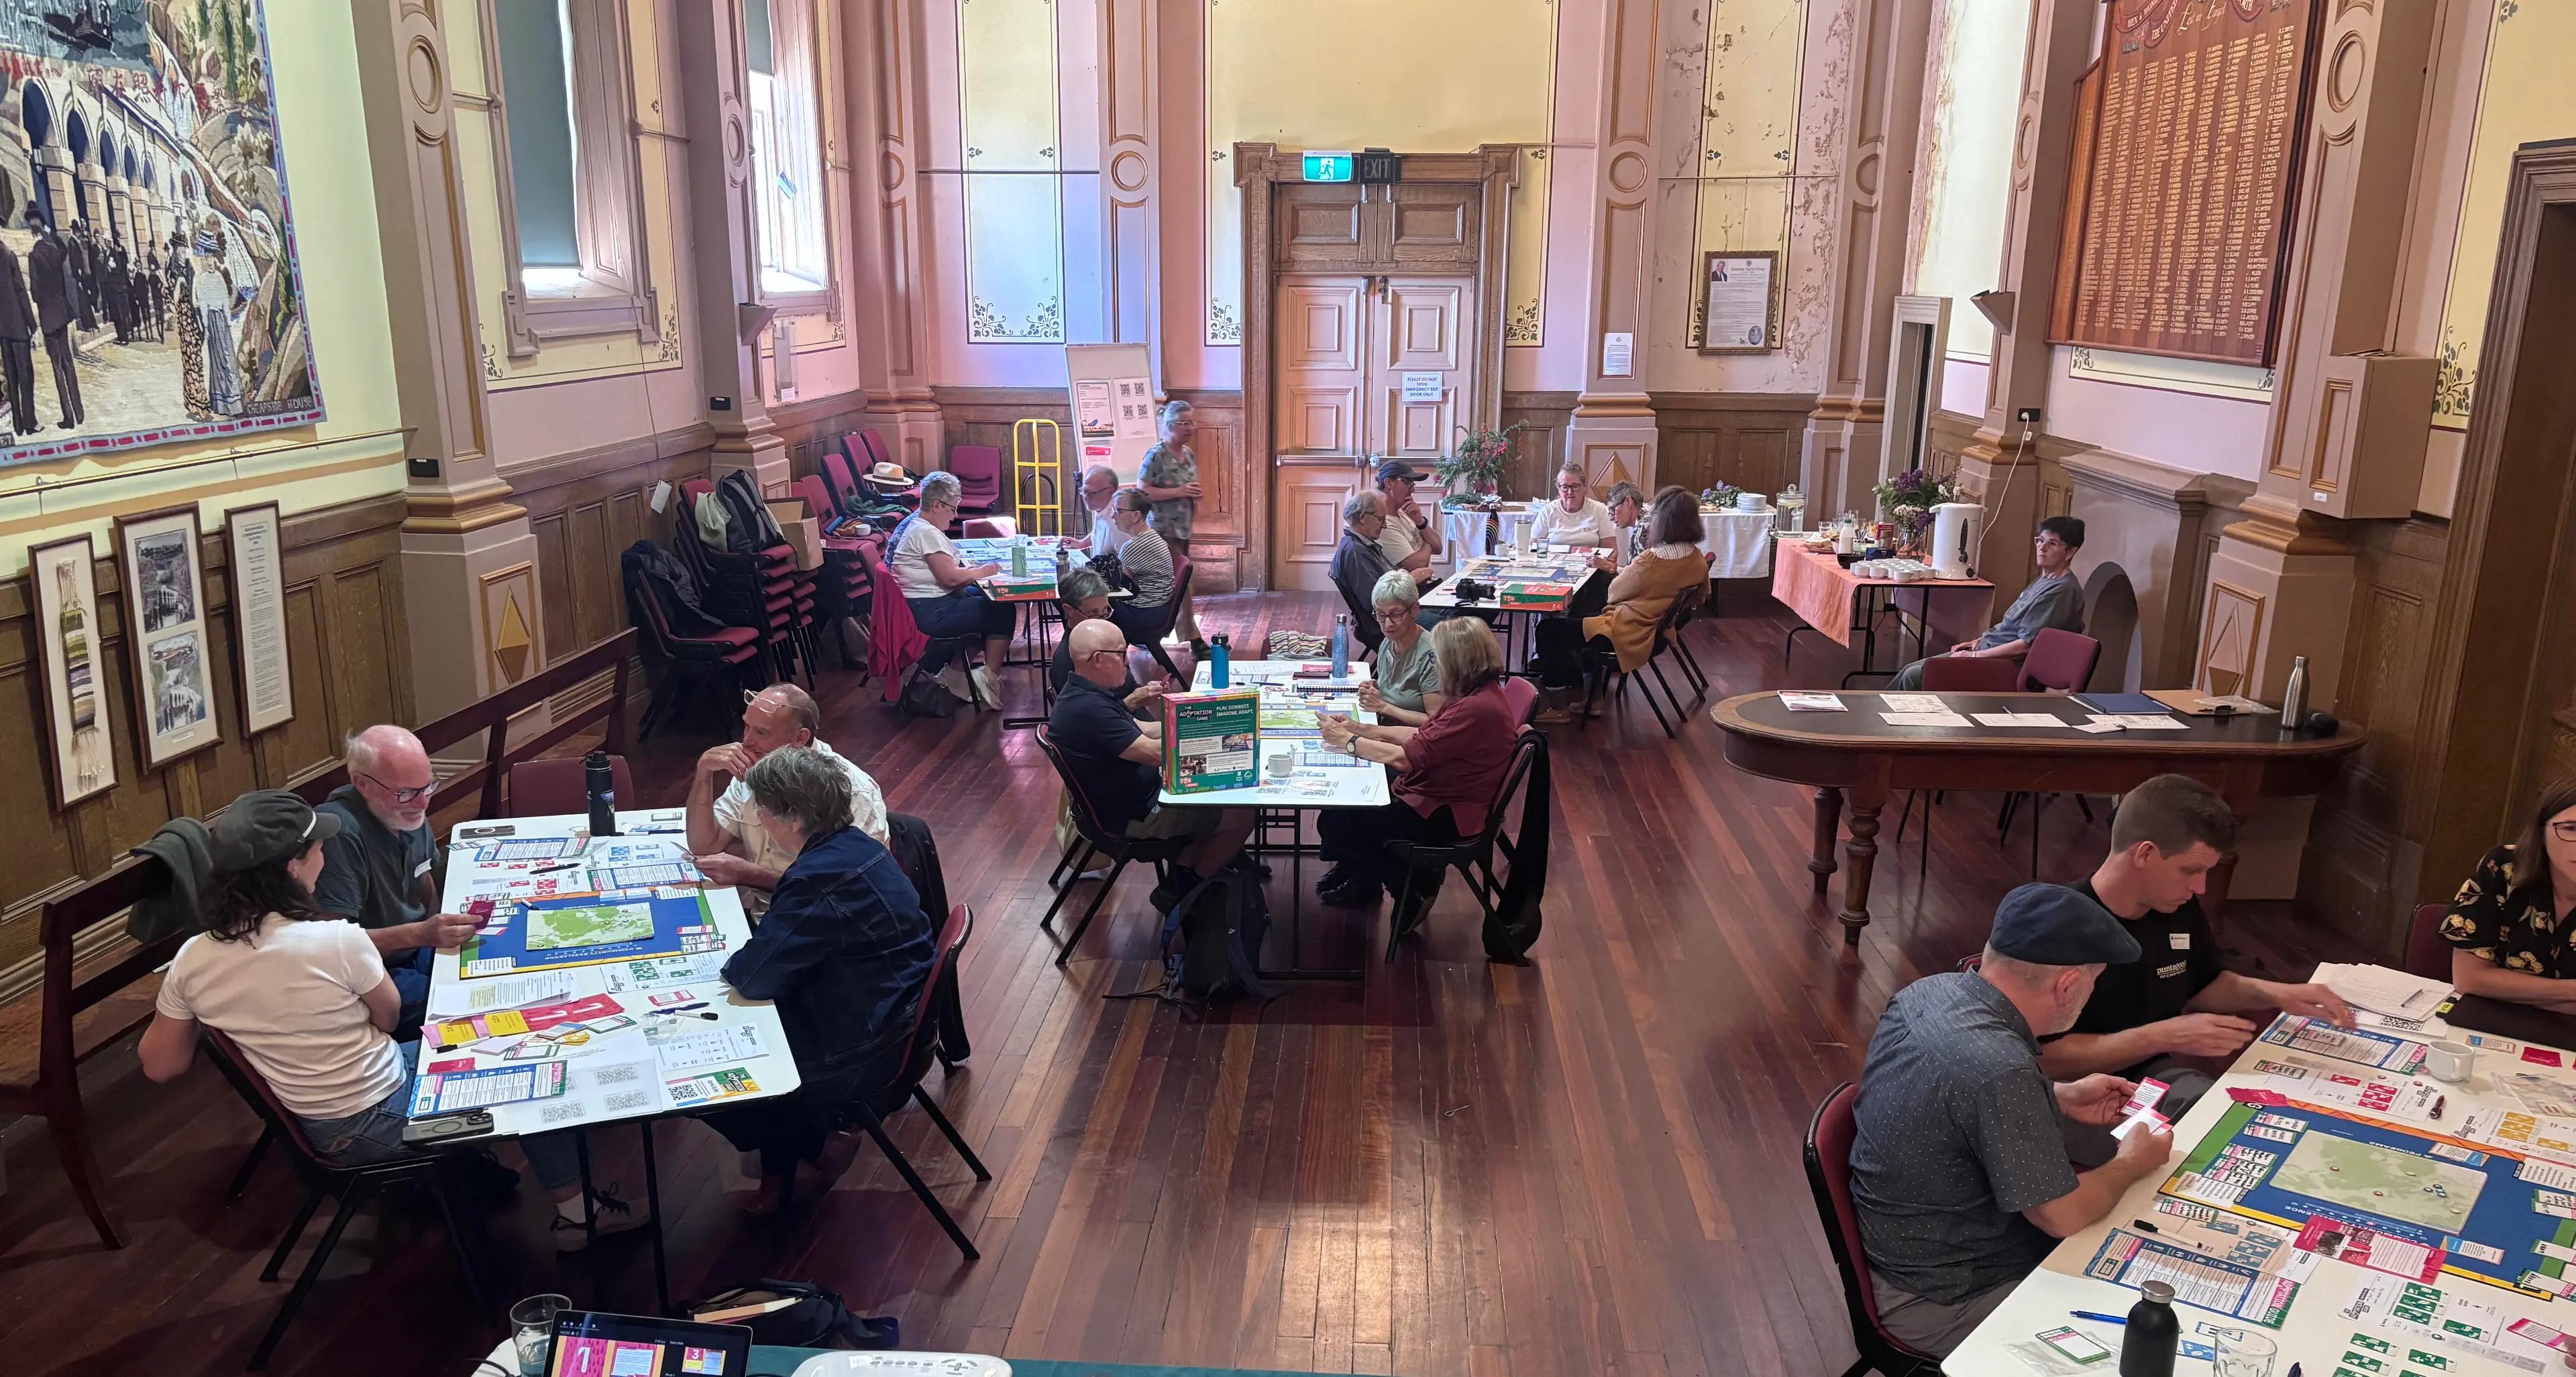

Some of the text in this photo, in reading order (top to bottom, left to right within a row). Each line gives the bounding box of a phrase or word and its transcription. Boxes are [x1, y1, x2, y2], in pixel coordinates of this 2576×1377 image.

[1364, 158, 1391, 179] EXIT
[287, 396, 312, 409] HOUSE
[1179, 709, 1213, 718] ADAPTATION
[2369, 1140, 2422, 1158] PROGRAMS
[2263, 1307, 2280, 1325] GUIDE
[577, 1346, 591, 1374] 1
[692, 1349, 700, 1360] 3
